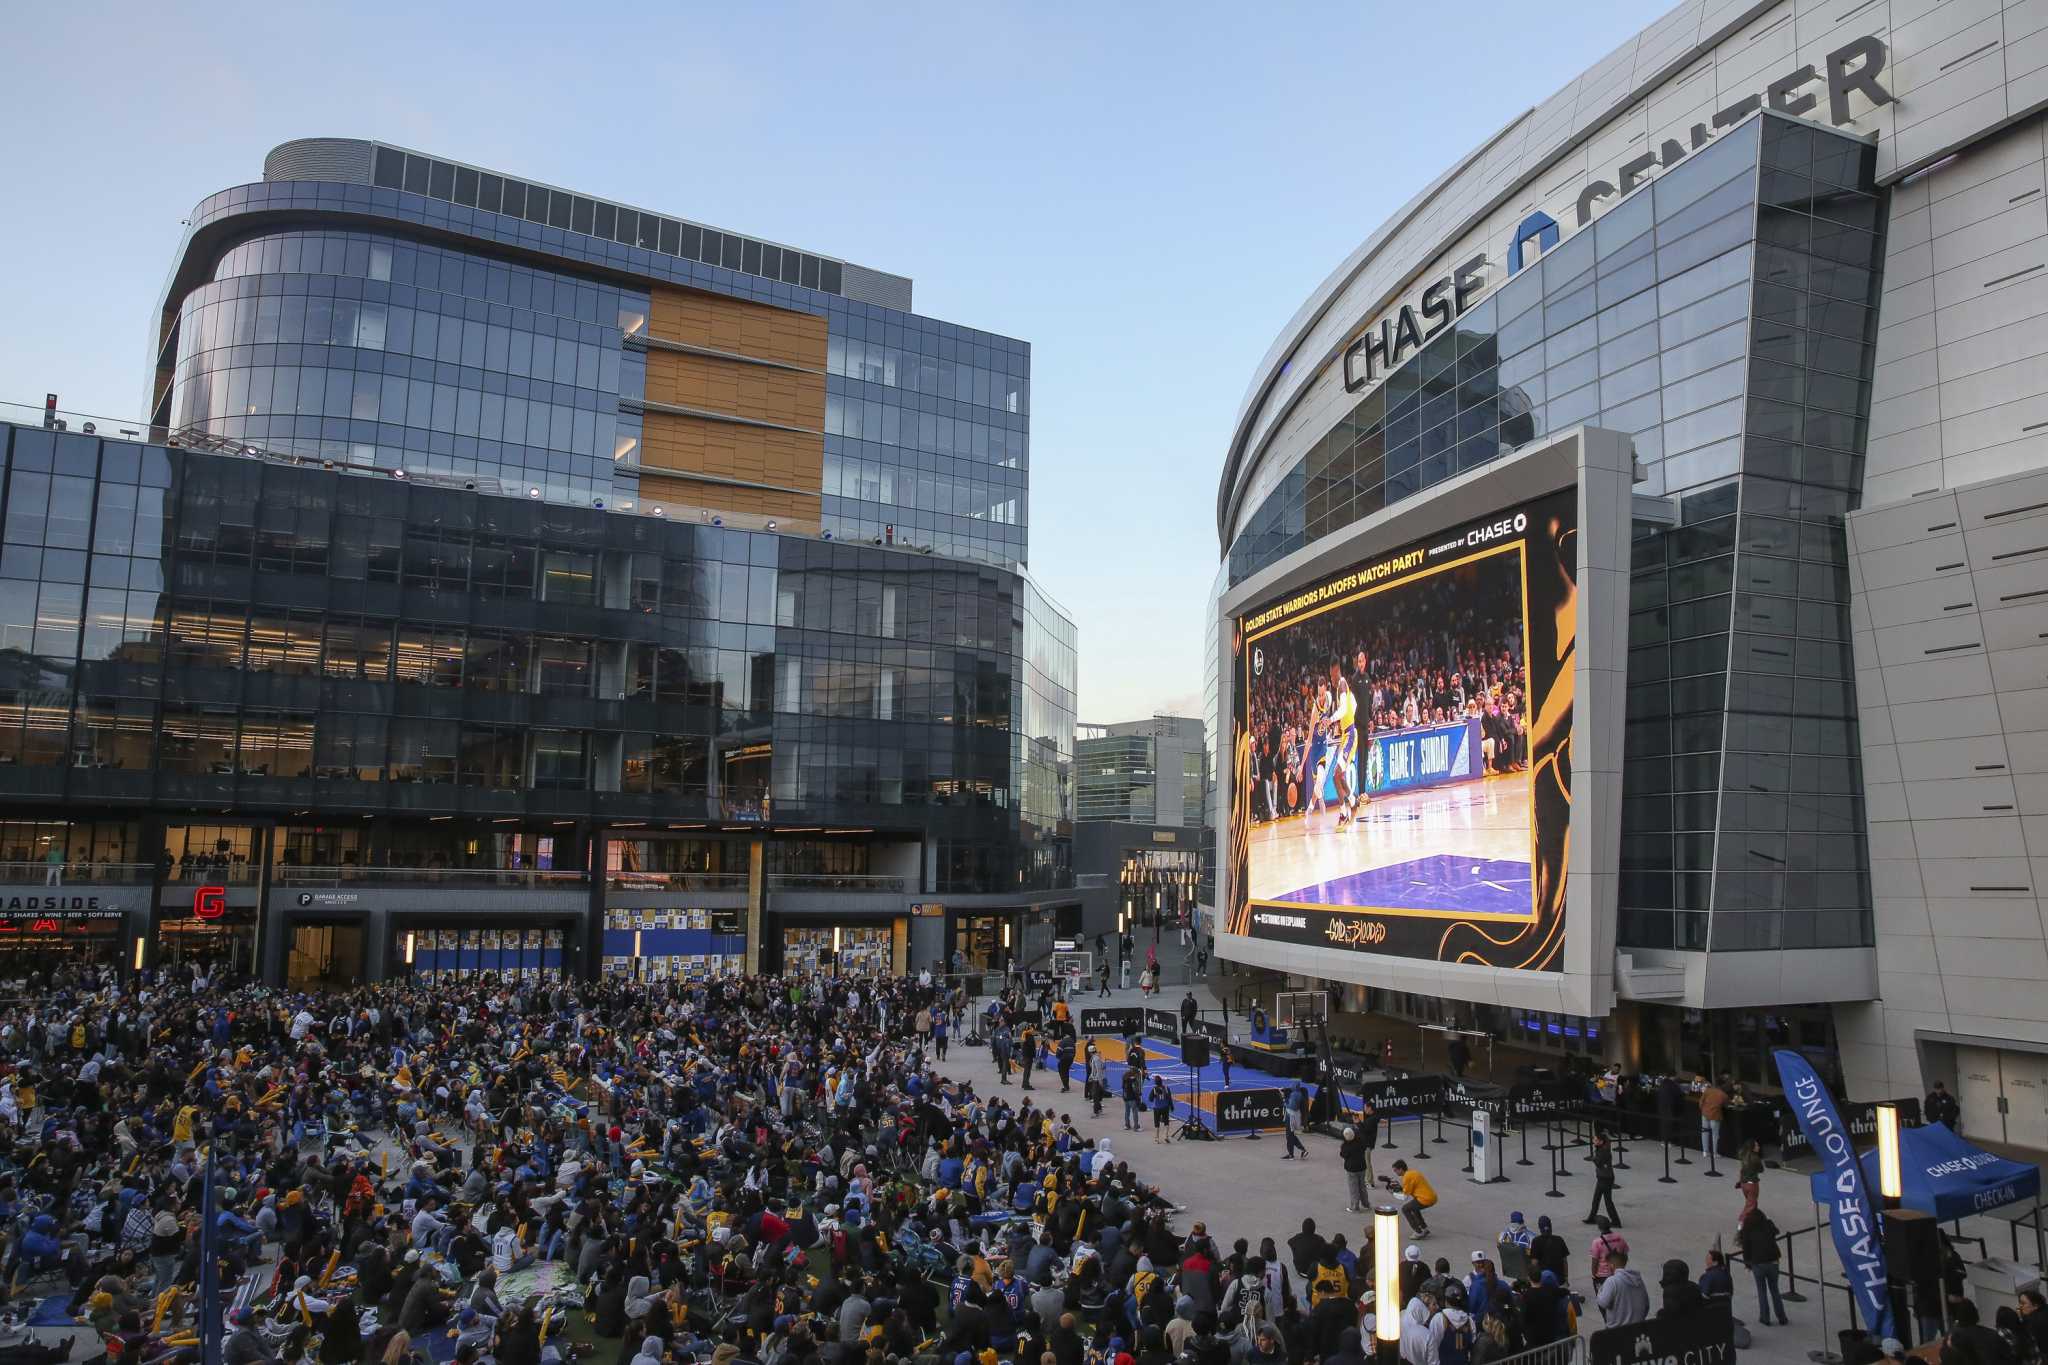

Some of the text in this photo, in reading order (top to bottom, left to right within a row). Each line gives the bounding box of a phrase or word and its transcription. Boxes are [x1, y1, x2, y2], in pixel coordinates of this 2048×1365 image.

[1344, 253, 1488, 393] CHASE
[1245, 518, 1512, 633] GOLDEN STATE WARRIORS PLAYOFFS WATCH PARTY PRESENTED BY CHASE
[1389, 735, 1449, 780] GAME 7 SUNDAY
[0, 897, 100, 909] ADSIDE
[194, 886, 225, 918] G
[1086, 1018, 1118, 1028] thrive
[1342, 1069, 1358, 1081] CITY
[1411, 1093, 1437, 1105] CITY
[1477, 1100, 1500, 1113] CITY
[1224, 1104, 1270, 1120] thrive
[1795, 1075, 1851, 1168] LOUNGE
[1926, 1160, 1967, 1177] CHASE
[1973, 1184, 2016, 1211] CHECK-IN
[1684, 1342, 1727, 1365] CITY
